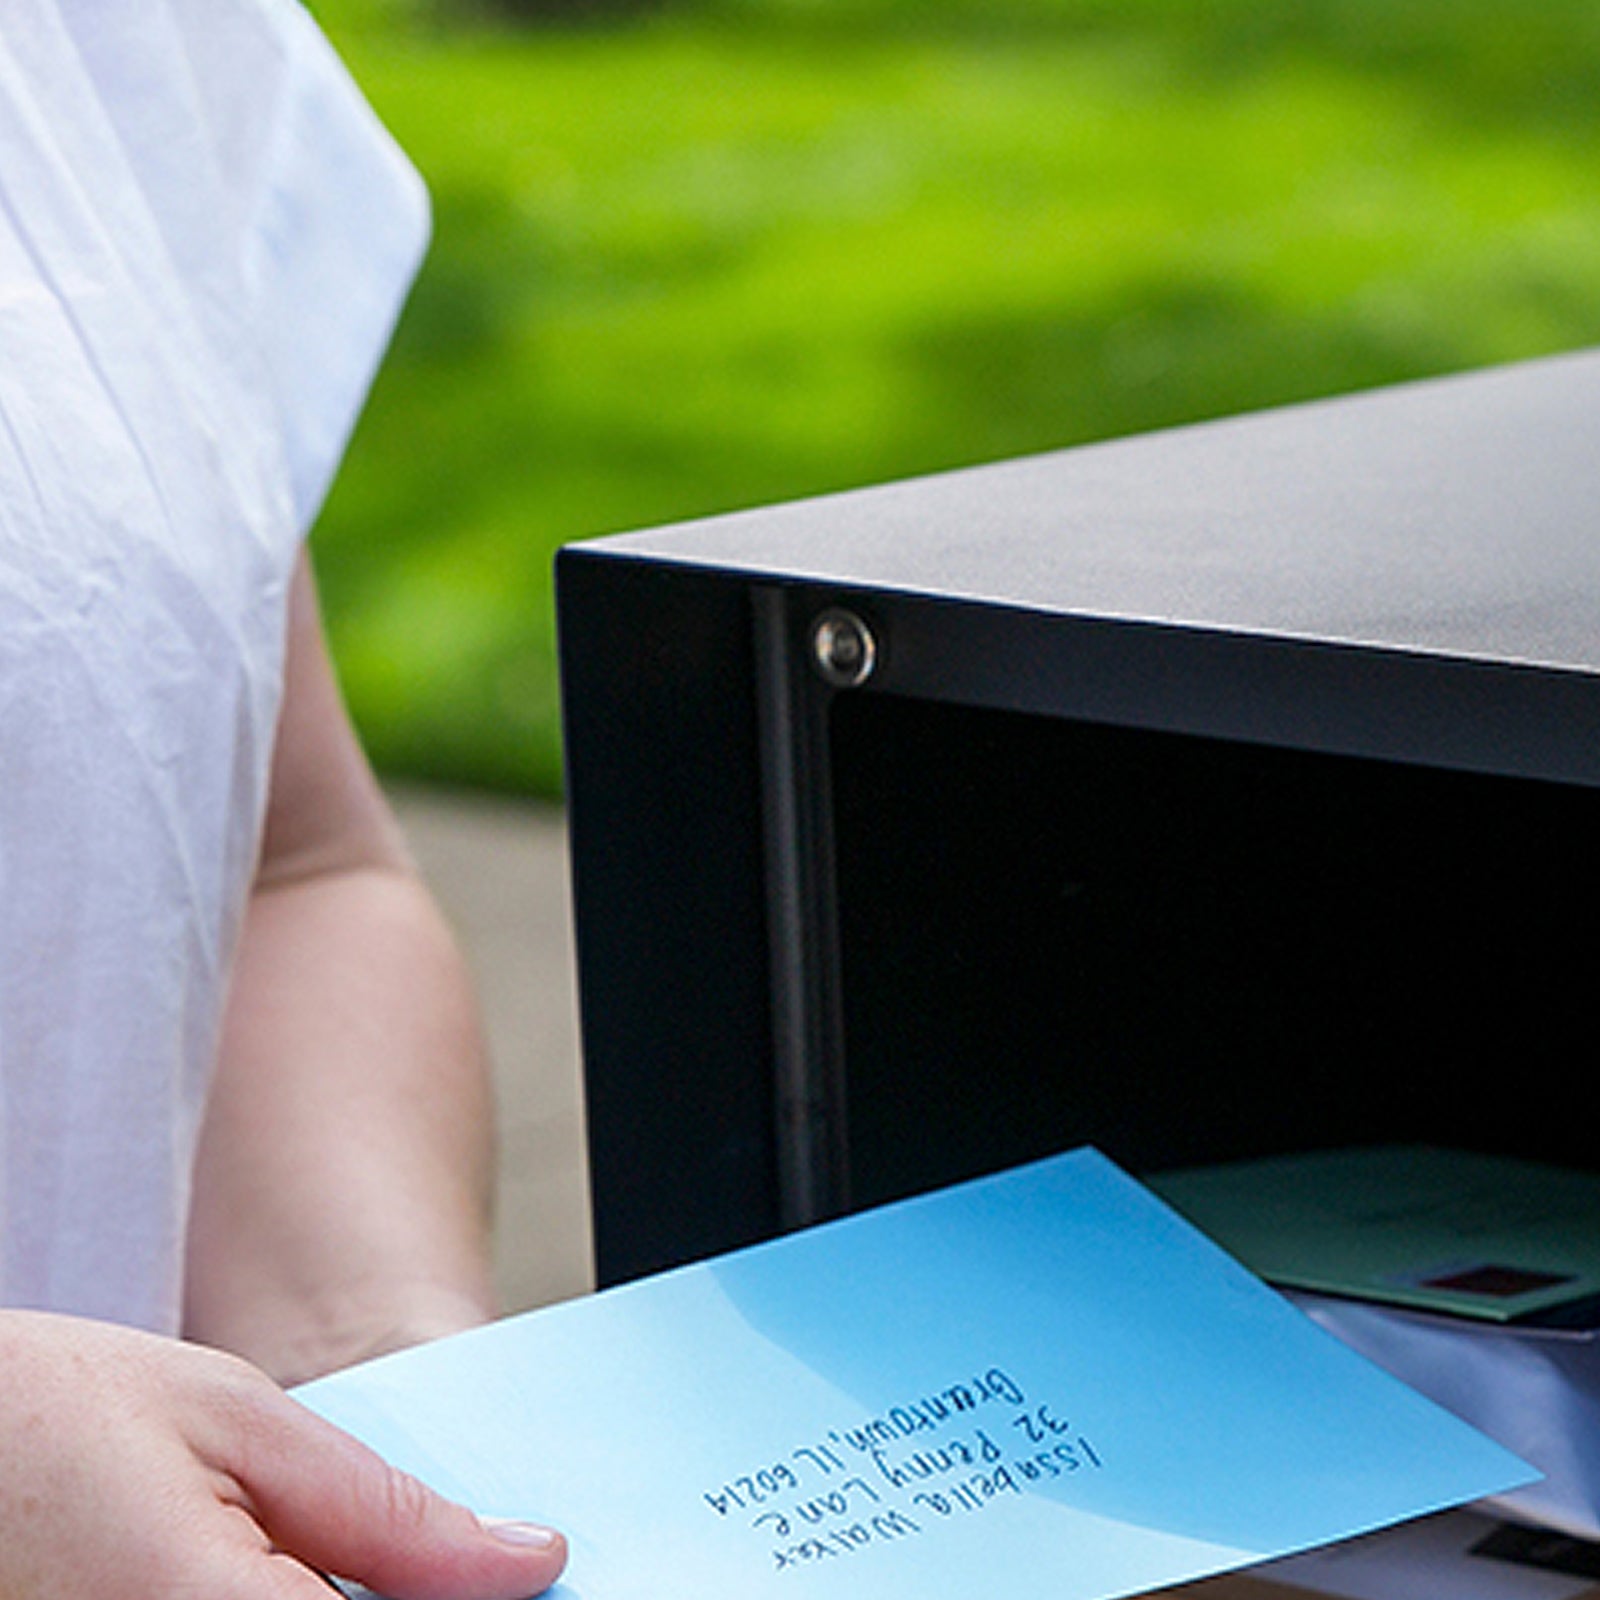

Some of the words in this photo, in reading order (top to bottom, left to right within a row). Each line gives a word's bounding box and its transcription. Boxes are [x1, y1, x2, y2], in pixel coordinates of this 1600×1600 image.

[1013, 1405, 1069, 1444] 32
[871, 1430, 1001, 1488] Penny
[704, 1463, 799, 1517] 60214
[752, 1477, 880, 1537] Lane
